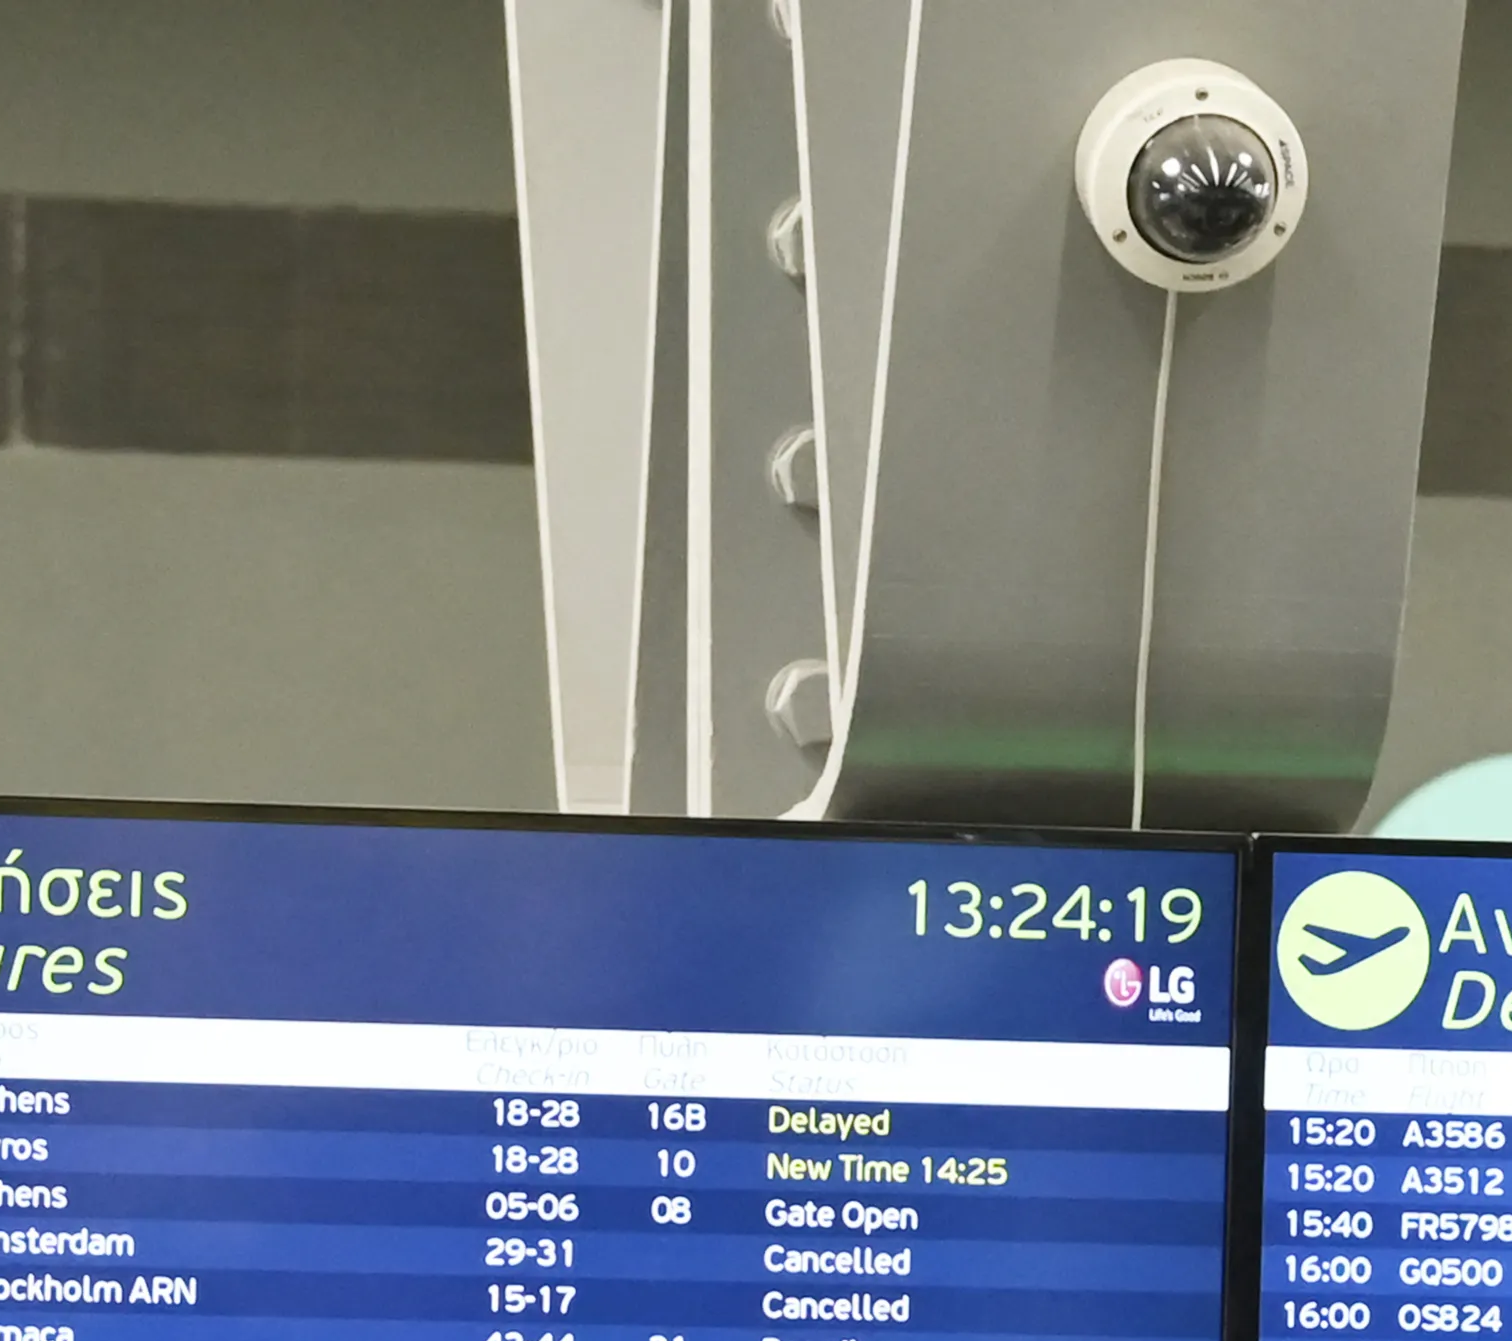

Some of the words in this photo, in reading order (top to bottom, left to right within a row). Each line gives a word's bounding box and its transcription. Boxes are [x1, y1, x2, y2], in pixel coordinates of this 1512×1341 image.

[908, 879, 1202, 944] 13:24:19
[1148, 964, 1197, 1005] LG
[493, 1097, 581, 1128] 18-28
[648, 1102, 707, 1132] 16B
[768, 1105, 890, 1141] Delayed
[492, 1144, 579, 1175] 18-28
[657, 1149, 696, 1178] 10
[766, 1152, 832, 1181] New
[838, 1153, 910, 1183] Time
[921, 1156, 1008, 1186] 14:25
[1287, 1163, 1375, 1193] 15:20
[1401, 1166, 1505, 1196] A3512
[485, 1191, 580, 1222] 05-06
[651, 1195, 692, 1225] 08
[764, 1198, 836, 1228] Gate
[841, 1200, 919, 1236] Open
[1286, 1209, 1373, 1239] 15:40
[128, 1275, 197, 1305] ARN
[488, 1284, 577, 1314] 15-17
[762, 1290, 910, 1322] Cancelled
